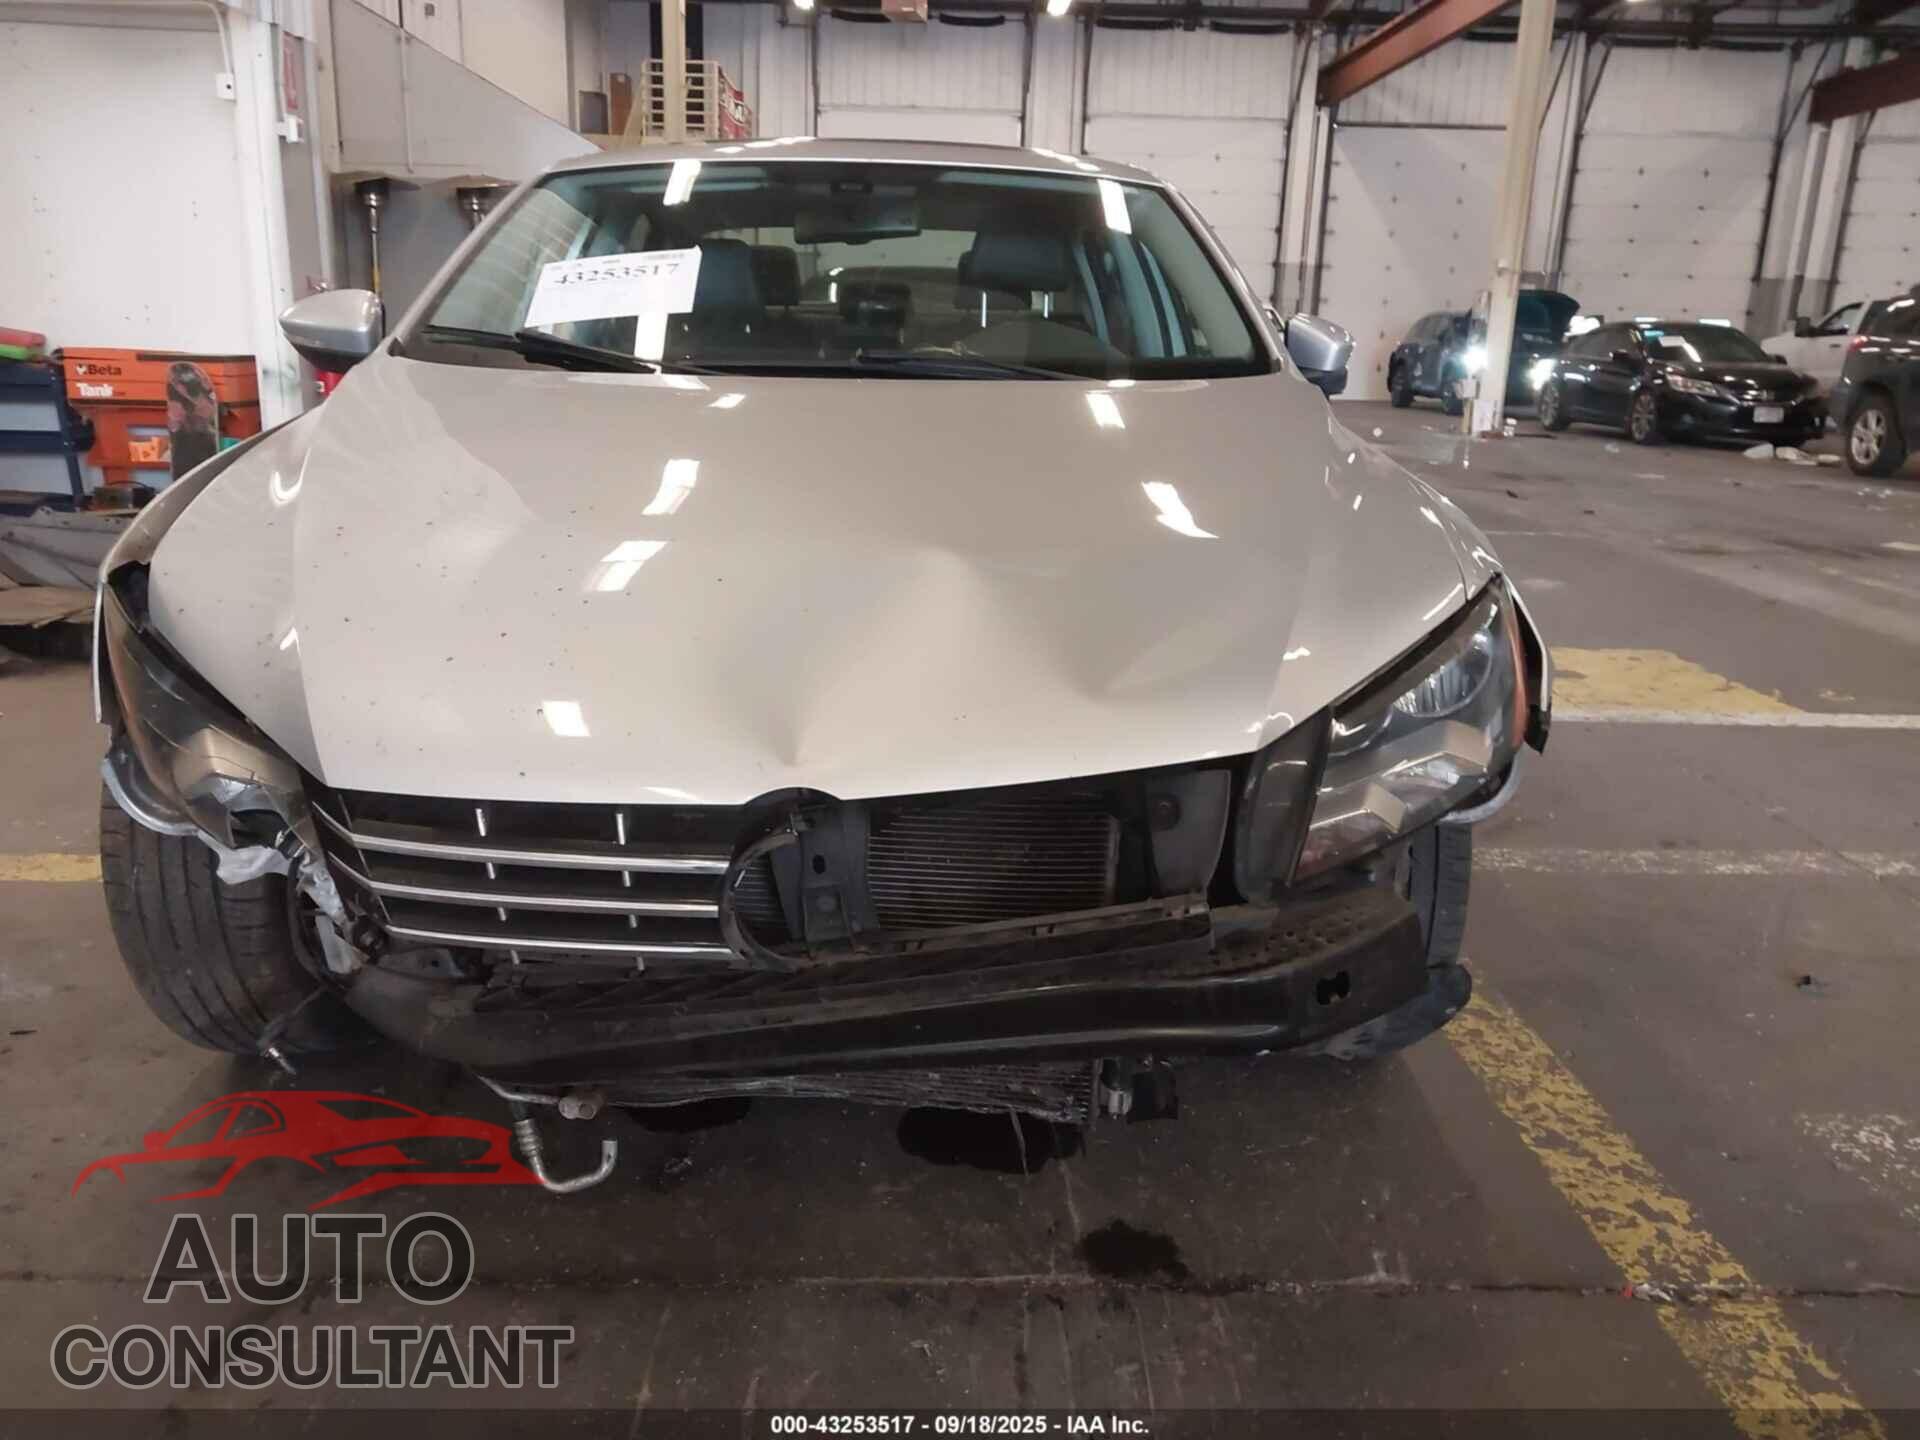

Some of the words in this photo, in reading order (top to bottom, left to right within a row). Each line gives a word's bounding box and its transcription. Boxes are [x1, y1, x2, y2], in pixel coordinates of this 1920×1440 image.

[554, 263, 680, 285] 43253517
[88, 364, 122, 376] Beta
[76, 383, 113, 397] Tank
